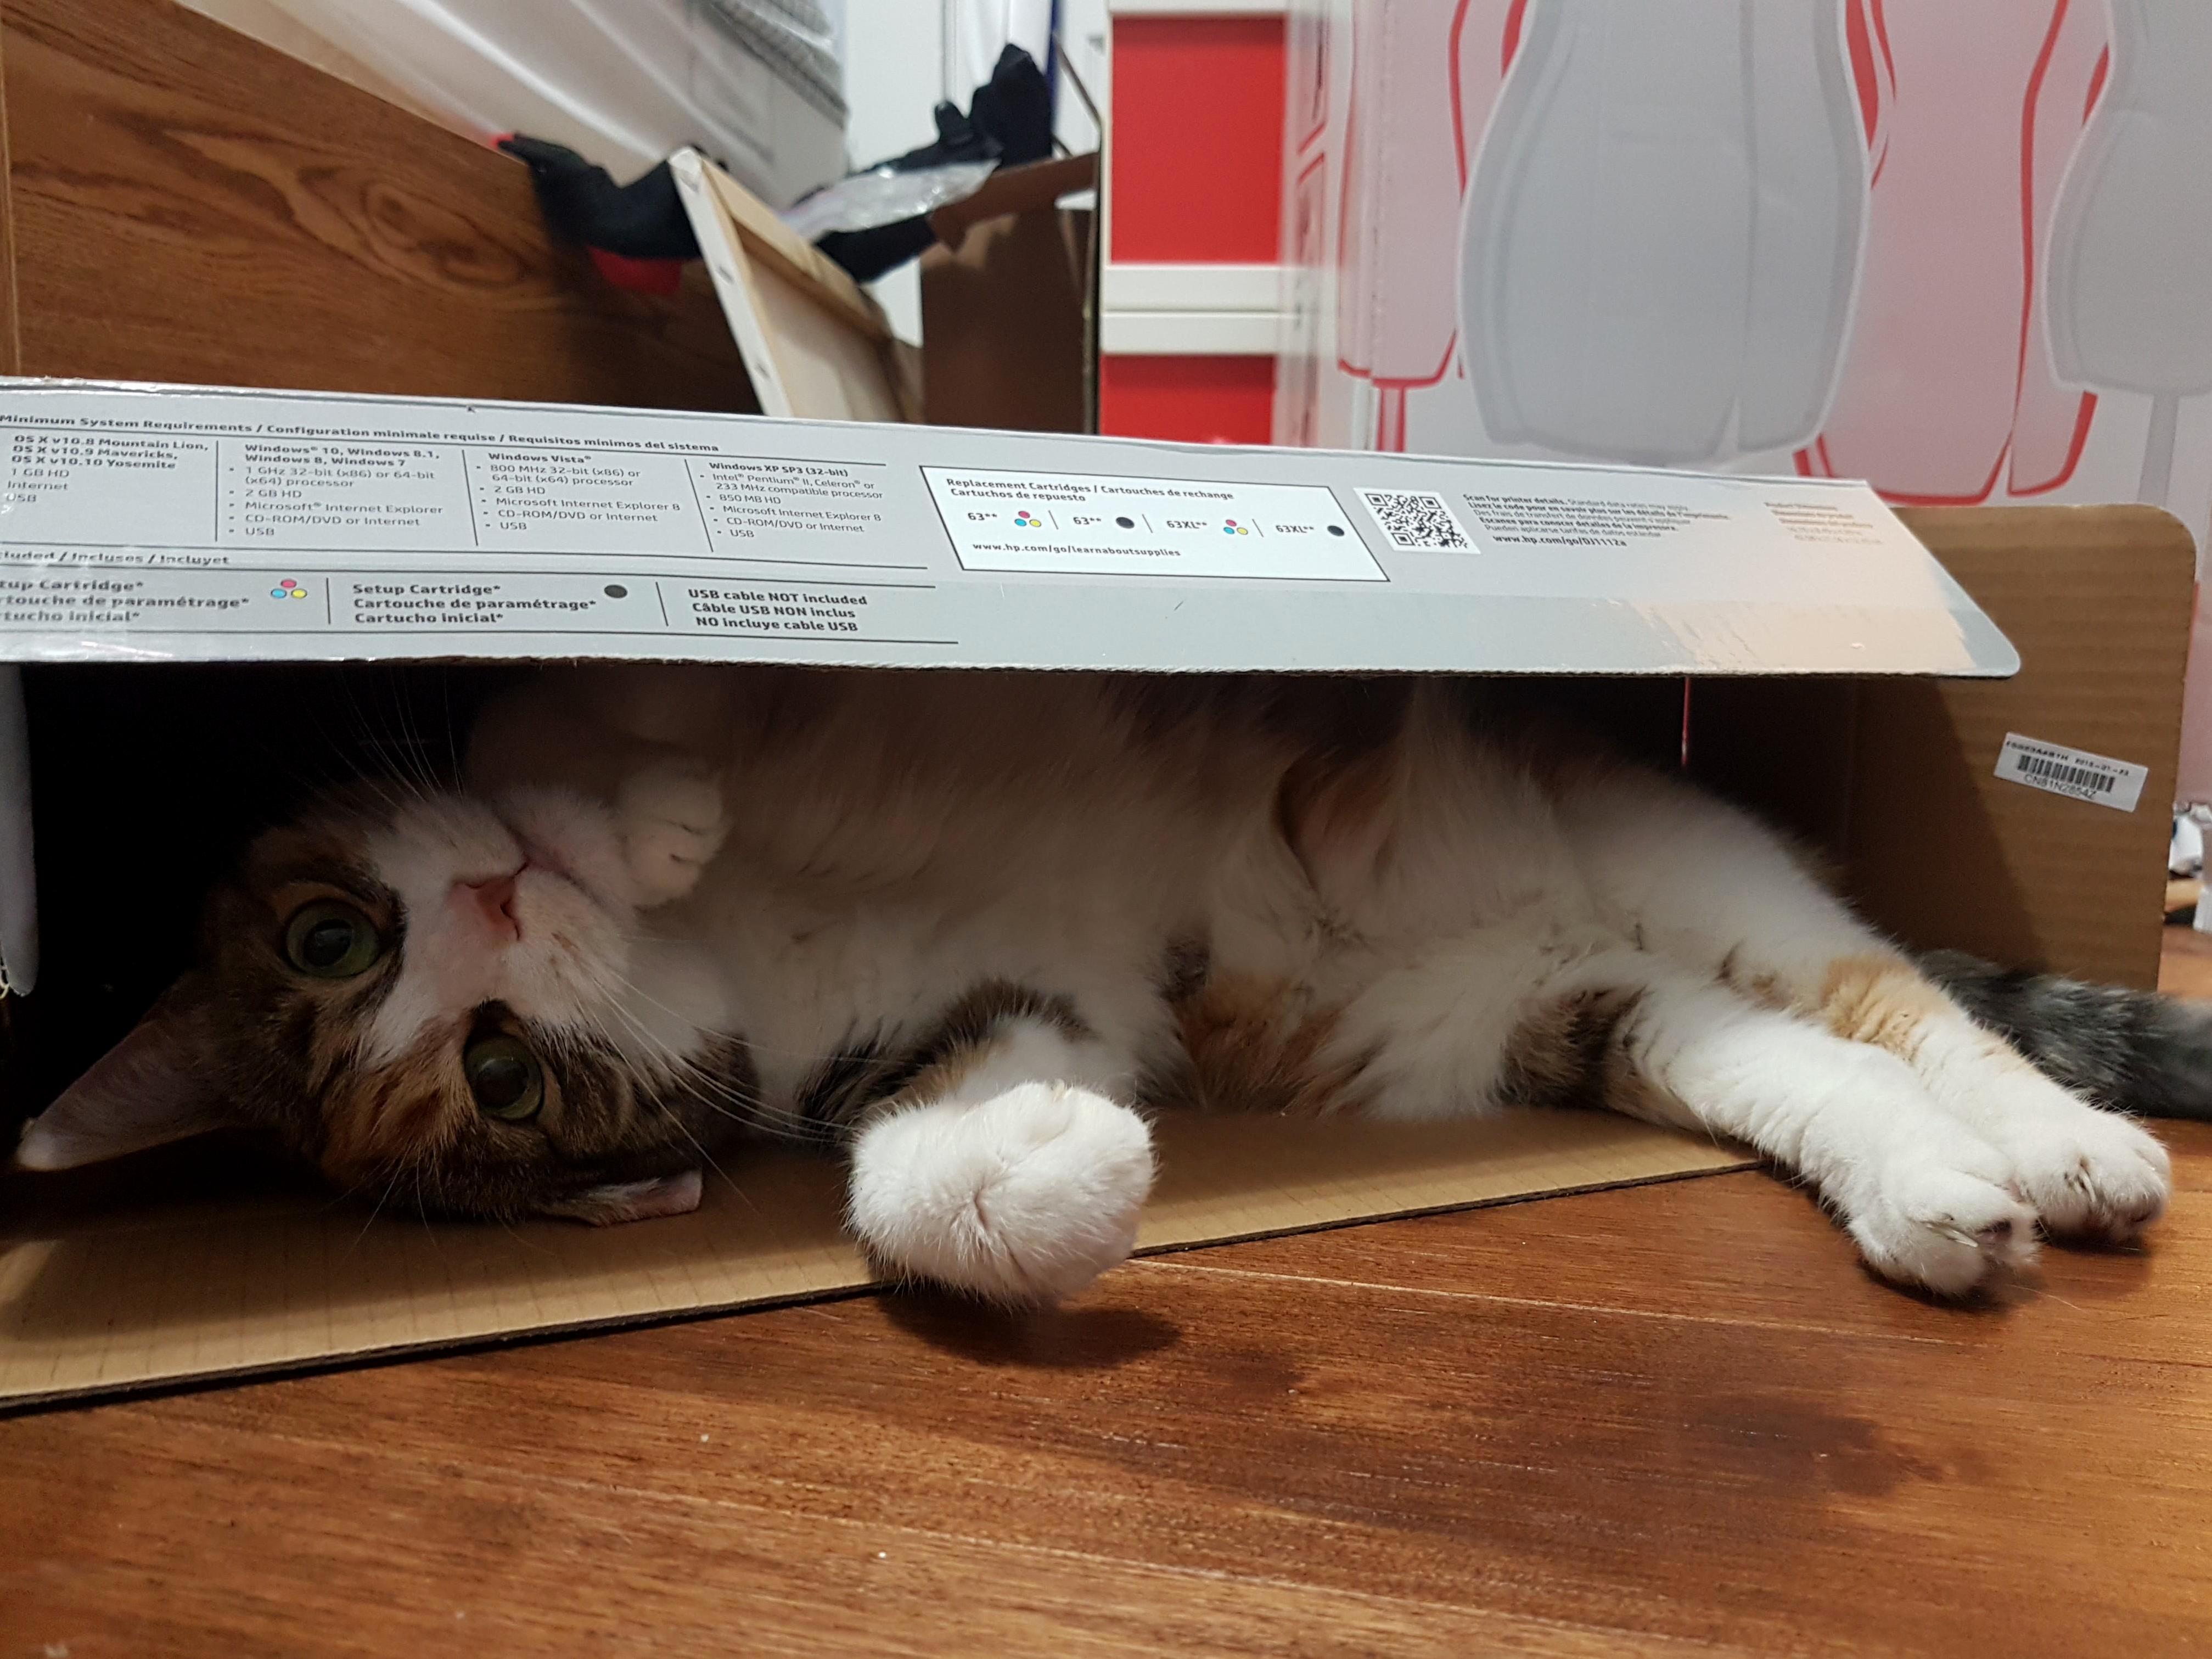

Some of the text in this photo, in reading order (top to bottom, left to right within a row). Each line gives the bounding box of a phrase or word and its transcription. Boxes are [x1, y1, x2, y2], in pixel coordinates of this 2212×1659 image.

[0, 415, 719, 452] Minimum System Requirements Configuration minimale requise Requisitos mínimos del sistema
[14, 435, 35, 443] OS
[98, 438, 169, 449] Mountain
[173, 441, 208, 451] Lion,
[13, 445, 33, 453] OS
[37, 446, 47, 454] X
[97, 449, 178, 460] Mavericks,
[322, 447, 344, 456] 10,
[347, 447, 410, 457] Windows
[413, 450, 440, 459] 8.1,
[488, 452, 548, 462] Windows
[12, 455, 31, 464] OS
[50, 457, 103, 466] v10.10
[106, 459, 176, 469] Yosemite
[245, 453, 310, 463] Windows
[314, 456, 327, 466] 8,
[331, 457, 395, 466] Windows
[23, 468, 70, 478] GB HD
[257, 467, 285, 475] GHz
[290, 468, 332, 477] 32-bit
[336, 469, 372, 479] (x86)
[490, 464, 515, 473] 800
[519, 465, 546, 473] MHz
[550, 466, 589, 475] 32-bit
[592, 468, 624, 477] (x86)
[709, 462, 762, 472] Windows
[805, 467, 849, 477] (32-bit)
[7, 480, 68, 490] Internet
[245, 476, 353, 487] (x64) processor
[492, 474, 633, 486] 64-bit (x64) processor
[258, 489, 302, 498] GB HD
[527, 486, 546, 495] HD
[740, 483, 766, 492] MHz
[768, 486, 829, 496] compatible
[830, 490, 883, 498] processor
[946, 478, 1027, 491] Replacement
[1029, 483, 1091, 493] Cartridges
[1101, 485, 1165, 496] Cartouches
[1182, 490, 1234, 500] rechange
[951, 488, 1013, 498] Cartuchos
[1015, 491, 1030, 499] de
[496, 497, 669, 511] Microsoft Internet Explorer
[719, 494, 781, 505] 850 MB HD
[325, 503, 381, 513] Internet
[386, 505, 443, 514] Explorer
[723, 505, 871, 521] Microsoft Internet Explorer
[245, 514, 341, 524] CD-ROM/DVD
[364, 517, 419, 526] Internet
[498, 509, 586, 519] CD-ROM/DVD
[606, 513, 658, 522] Internet
[500, 522, 527, 530] USB
[726, 517, 803, 529] CD-ROM/DVD
[819, 523, 865, 533] Internet
[245, 527, 274, 536] USB
[729, 529, 755, 537] USB
[0, 551, 55, 560] luded
[973, 543, 1181, 557] www.hp.com/go/learnaboutsupplies
[353, 584, 405, 596] Setup
[82, 595, 106, 606] de
[354, 598, 445, 608] Cartouche
[450, 598, 470, 608] de
[688, 589, 868, 605] USB cable NOT included
[692, 603, 856, 618] Câble USB NON inclus
[355, 613, 437, 623] Cartucho
[695, 616, 858, 631] NO incluye cable USB
